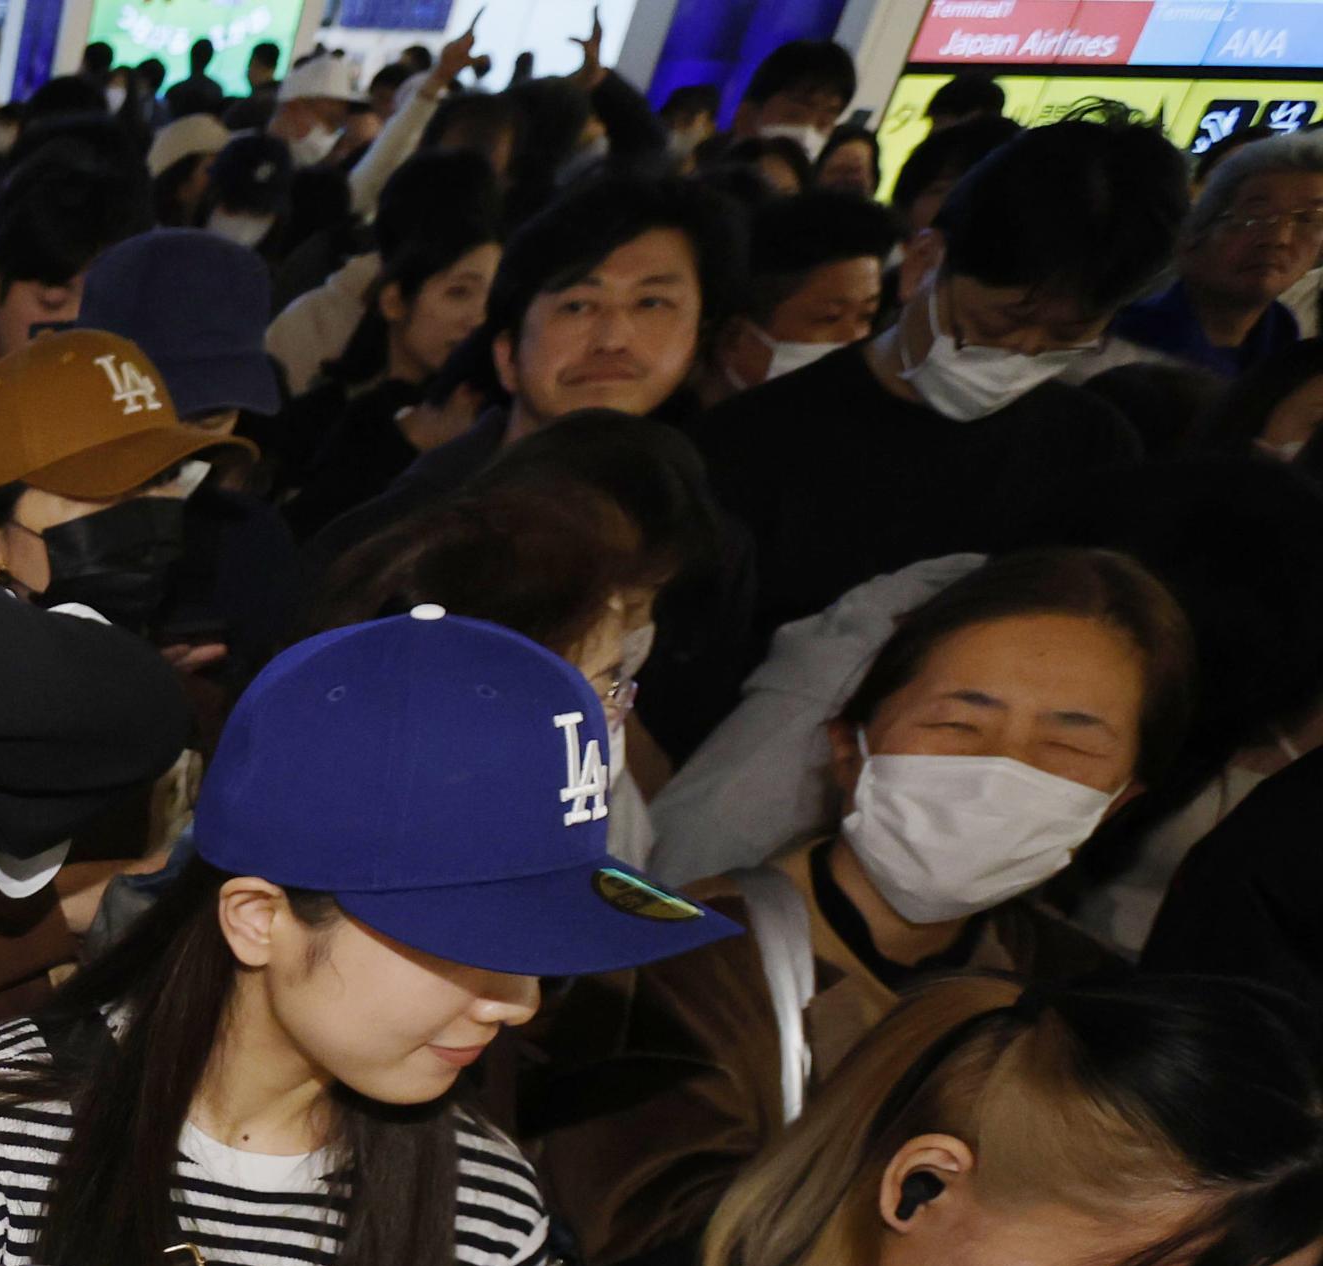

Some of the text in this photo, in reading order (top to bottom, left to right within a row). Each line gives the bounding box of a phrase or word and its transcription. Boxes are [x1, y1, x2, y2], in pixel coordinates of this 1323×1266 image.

[939, 28, 1122, 57] Japan Airlines
[1217, 27, 1288, 58] ANA
[94, 354, 162, 415] LA
[553, 711, 608, 827] LA
